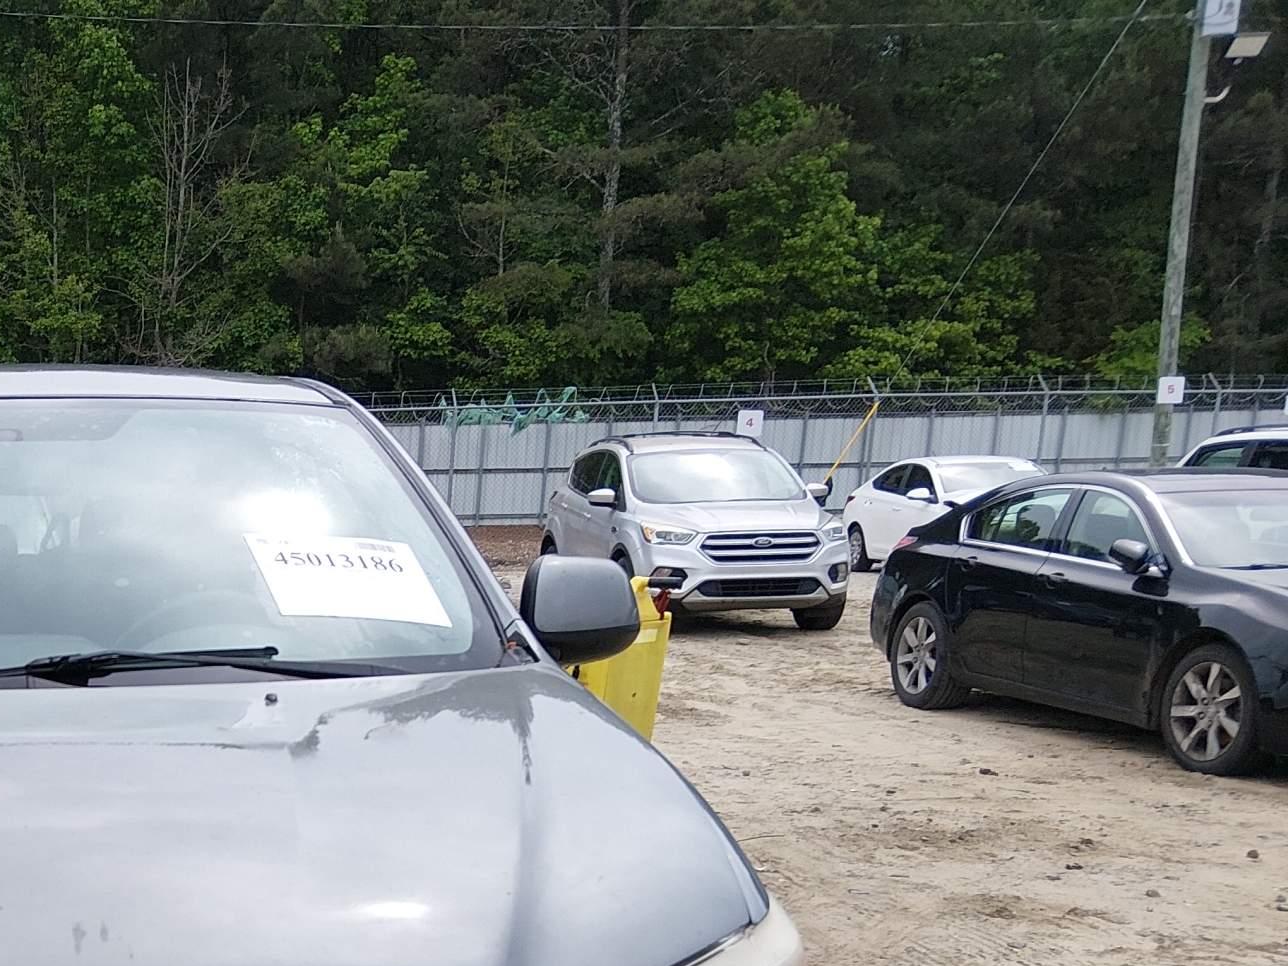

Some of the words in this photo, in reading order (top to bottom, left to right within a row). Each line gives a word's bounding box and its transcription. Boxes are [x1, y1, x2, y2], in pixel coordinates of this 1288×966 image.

[1167, 384, 1175, 394] 5
[746, 417, 755, 428] 4
[274, 551, 404, 573] 45013186
